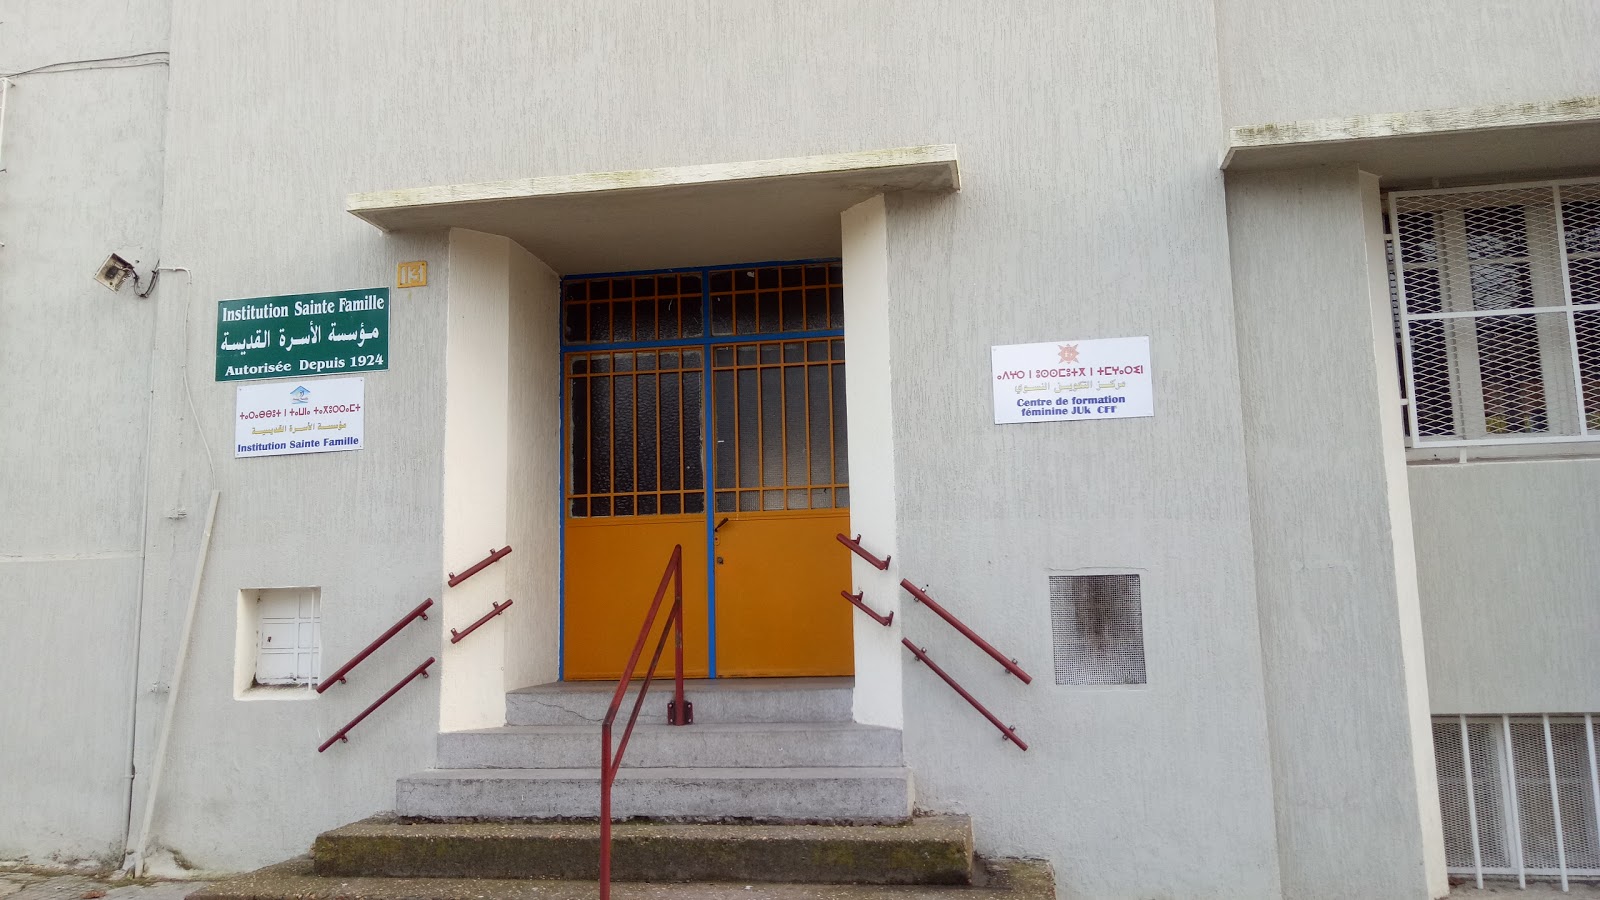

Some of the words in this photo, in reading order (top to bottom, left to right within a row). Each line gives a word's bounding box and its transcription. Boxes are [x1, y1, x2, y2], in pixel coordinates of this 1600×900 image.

[222, 303, 288, 321] Institution
[295, 300, 335, 316] Sainte
[339, 295, 384, 312] Famille
[221, 330, 270, 355] القديسة
[279, 321, 321, 351] الأسرة
[328, 323, 379, 347] مؤسسة
[225, 361, 291, 376] Autorisée
[299, 358, 345, 372] Depuis
[350, 354, 383, 367] 1924
[1054, 381, 1092, 393] التكوين
[1096, 379, 1126, 391] مركز
[1017, 398, 1052, 407] Centre
[1055, 397, 1068, 405] de
[1072, 396, 1126, 405] formation
[1021, 407, 1068, 416] féminine
[318, 421, 346, 431] مؤسسة
[238, 442, 286, 452] Institution
[290, 439, 320, 449] Sainte
[324, 437, 358, 446] Famille
